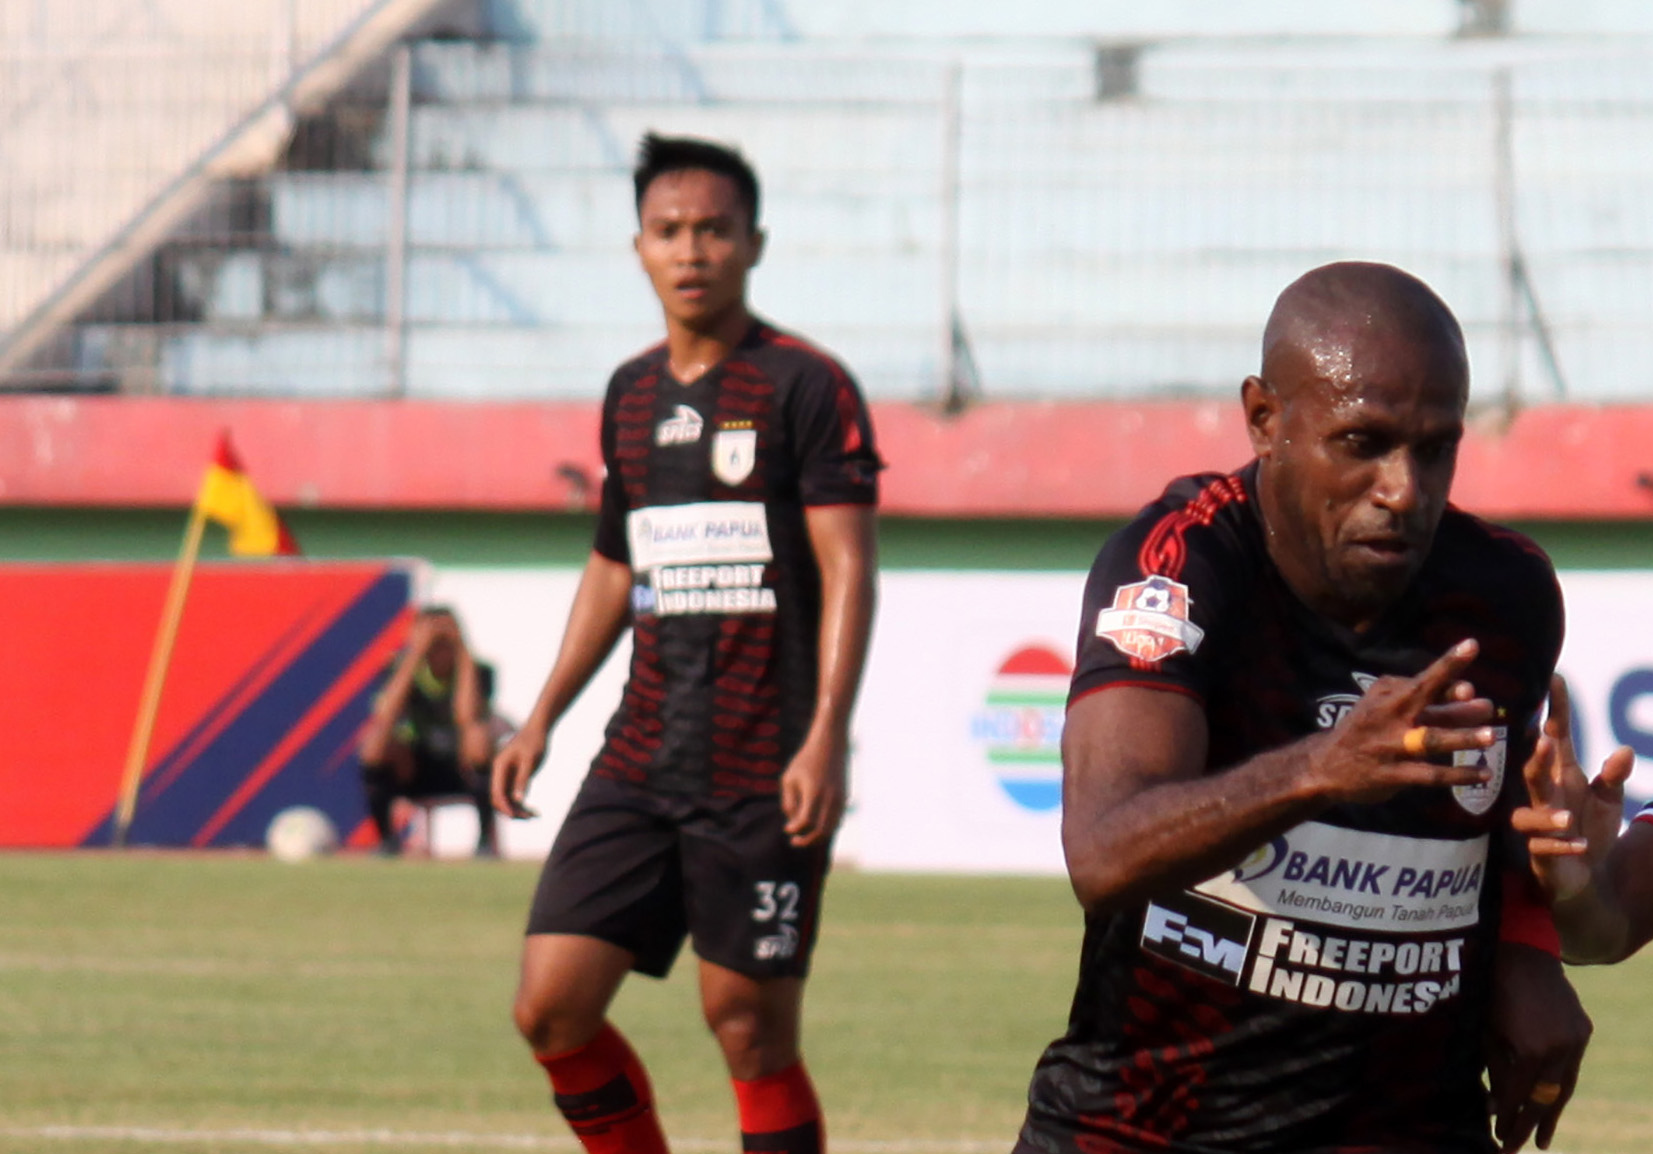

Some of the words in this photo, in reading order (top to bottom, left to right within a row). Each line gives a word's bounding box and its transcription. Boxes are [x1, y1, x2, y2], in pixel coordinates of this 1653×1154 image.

[653, 525, 697, 543] BANK
[705, 520, 761, 538] PAPUA
[653, 563, 765, 590] FREEPORT
[656, 587, 776, 615] INDONESIA
[1282, 850, 1390, 895] BANK
[1391, 862, 1482, 899] PAPUA
[752, 881, 800, 921] 32
[1276, 888, 1385, 920] Membangun
[1391, 904, 1436, 922] Tanah
[1434, 901, 1475, 920] Papua
[1258, 917, 1465, 976] FREEPORT
